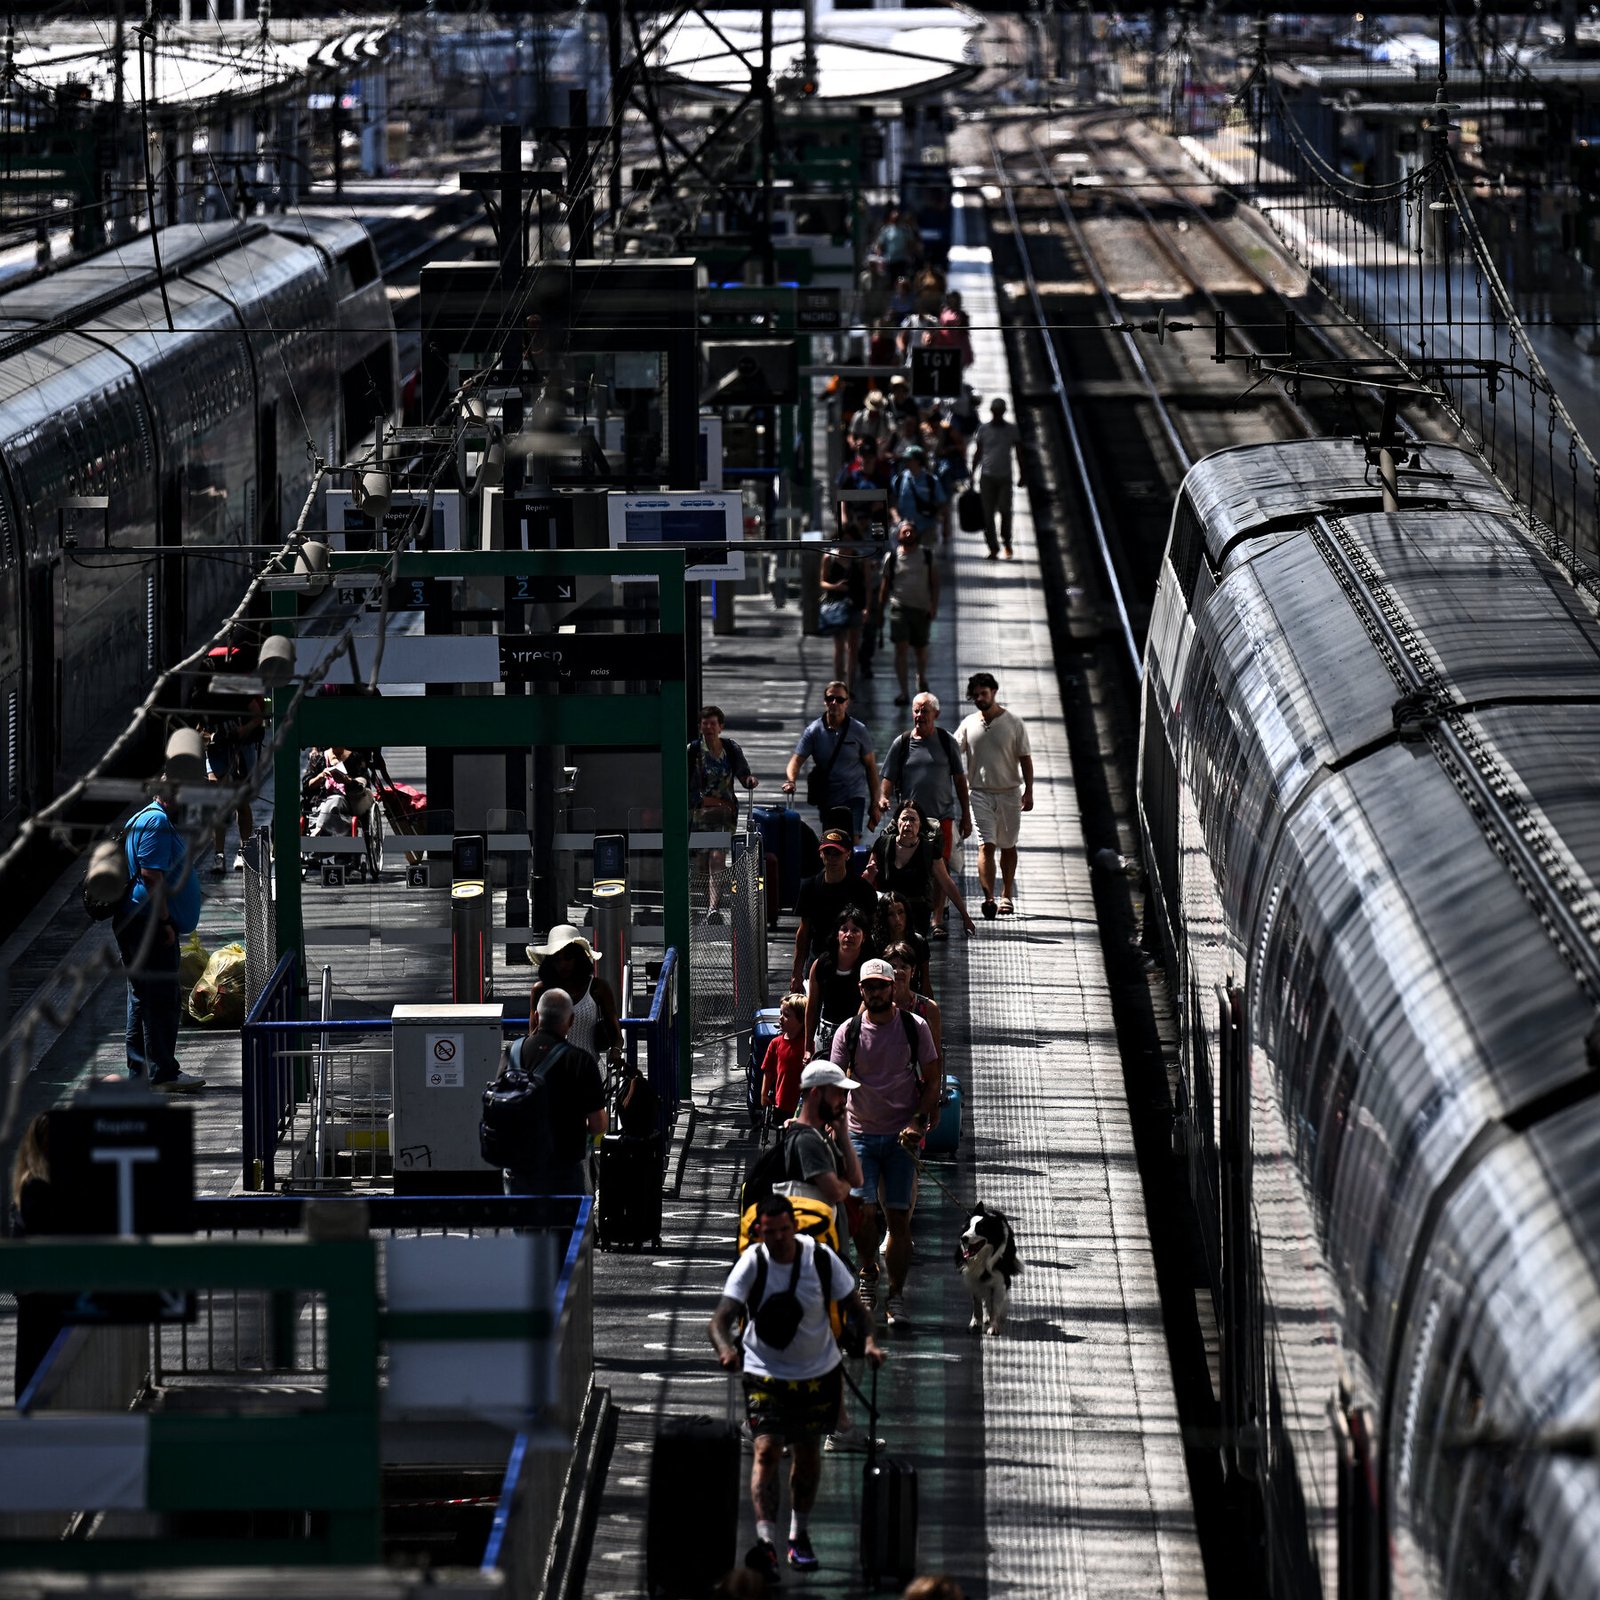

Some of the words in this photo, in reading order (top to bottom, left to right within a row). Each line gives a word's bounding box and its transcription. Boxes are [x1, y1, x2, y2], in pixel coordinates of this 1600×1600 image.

[921, 352, 953, 367] TGV
[929, 370, 940, 393] 1
[385, 511, 410, 519] Repère
[525, 504, 551, 512] Repère
[413, 588, 425, 604] 3
[517, 581, 529, 597] 2
[89, 1145, 160, 1239] T
